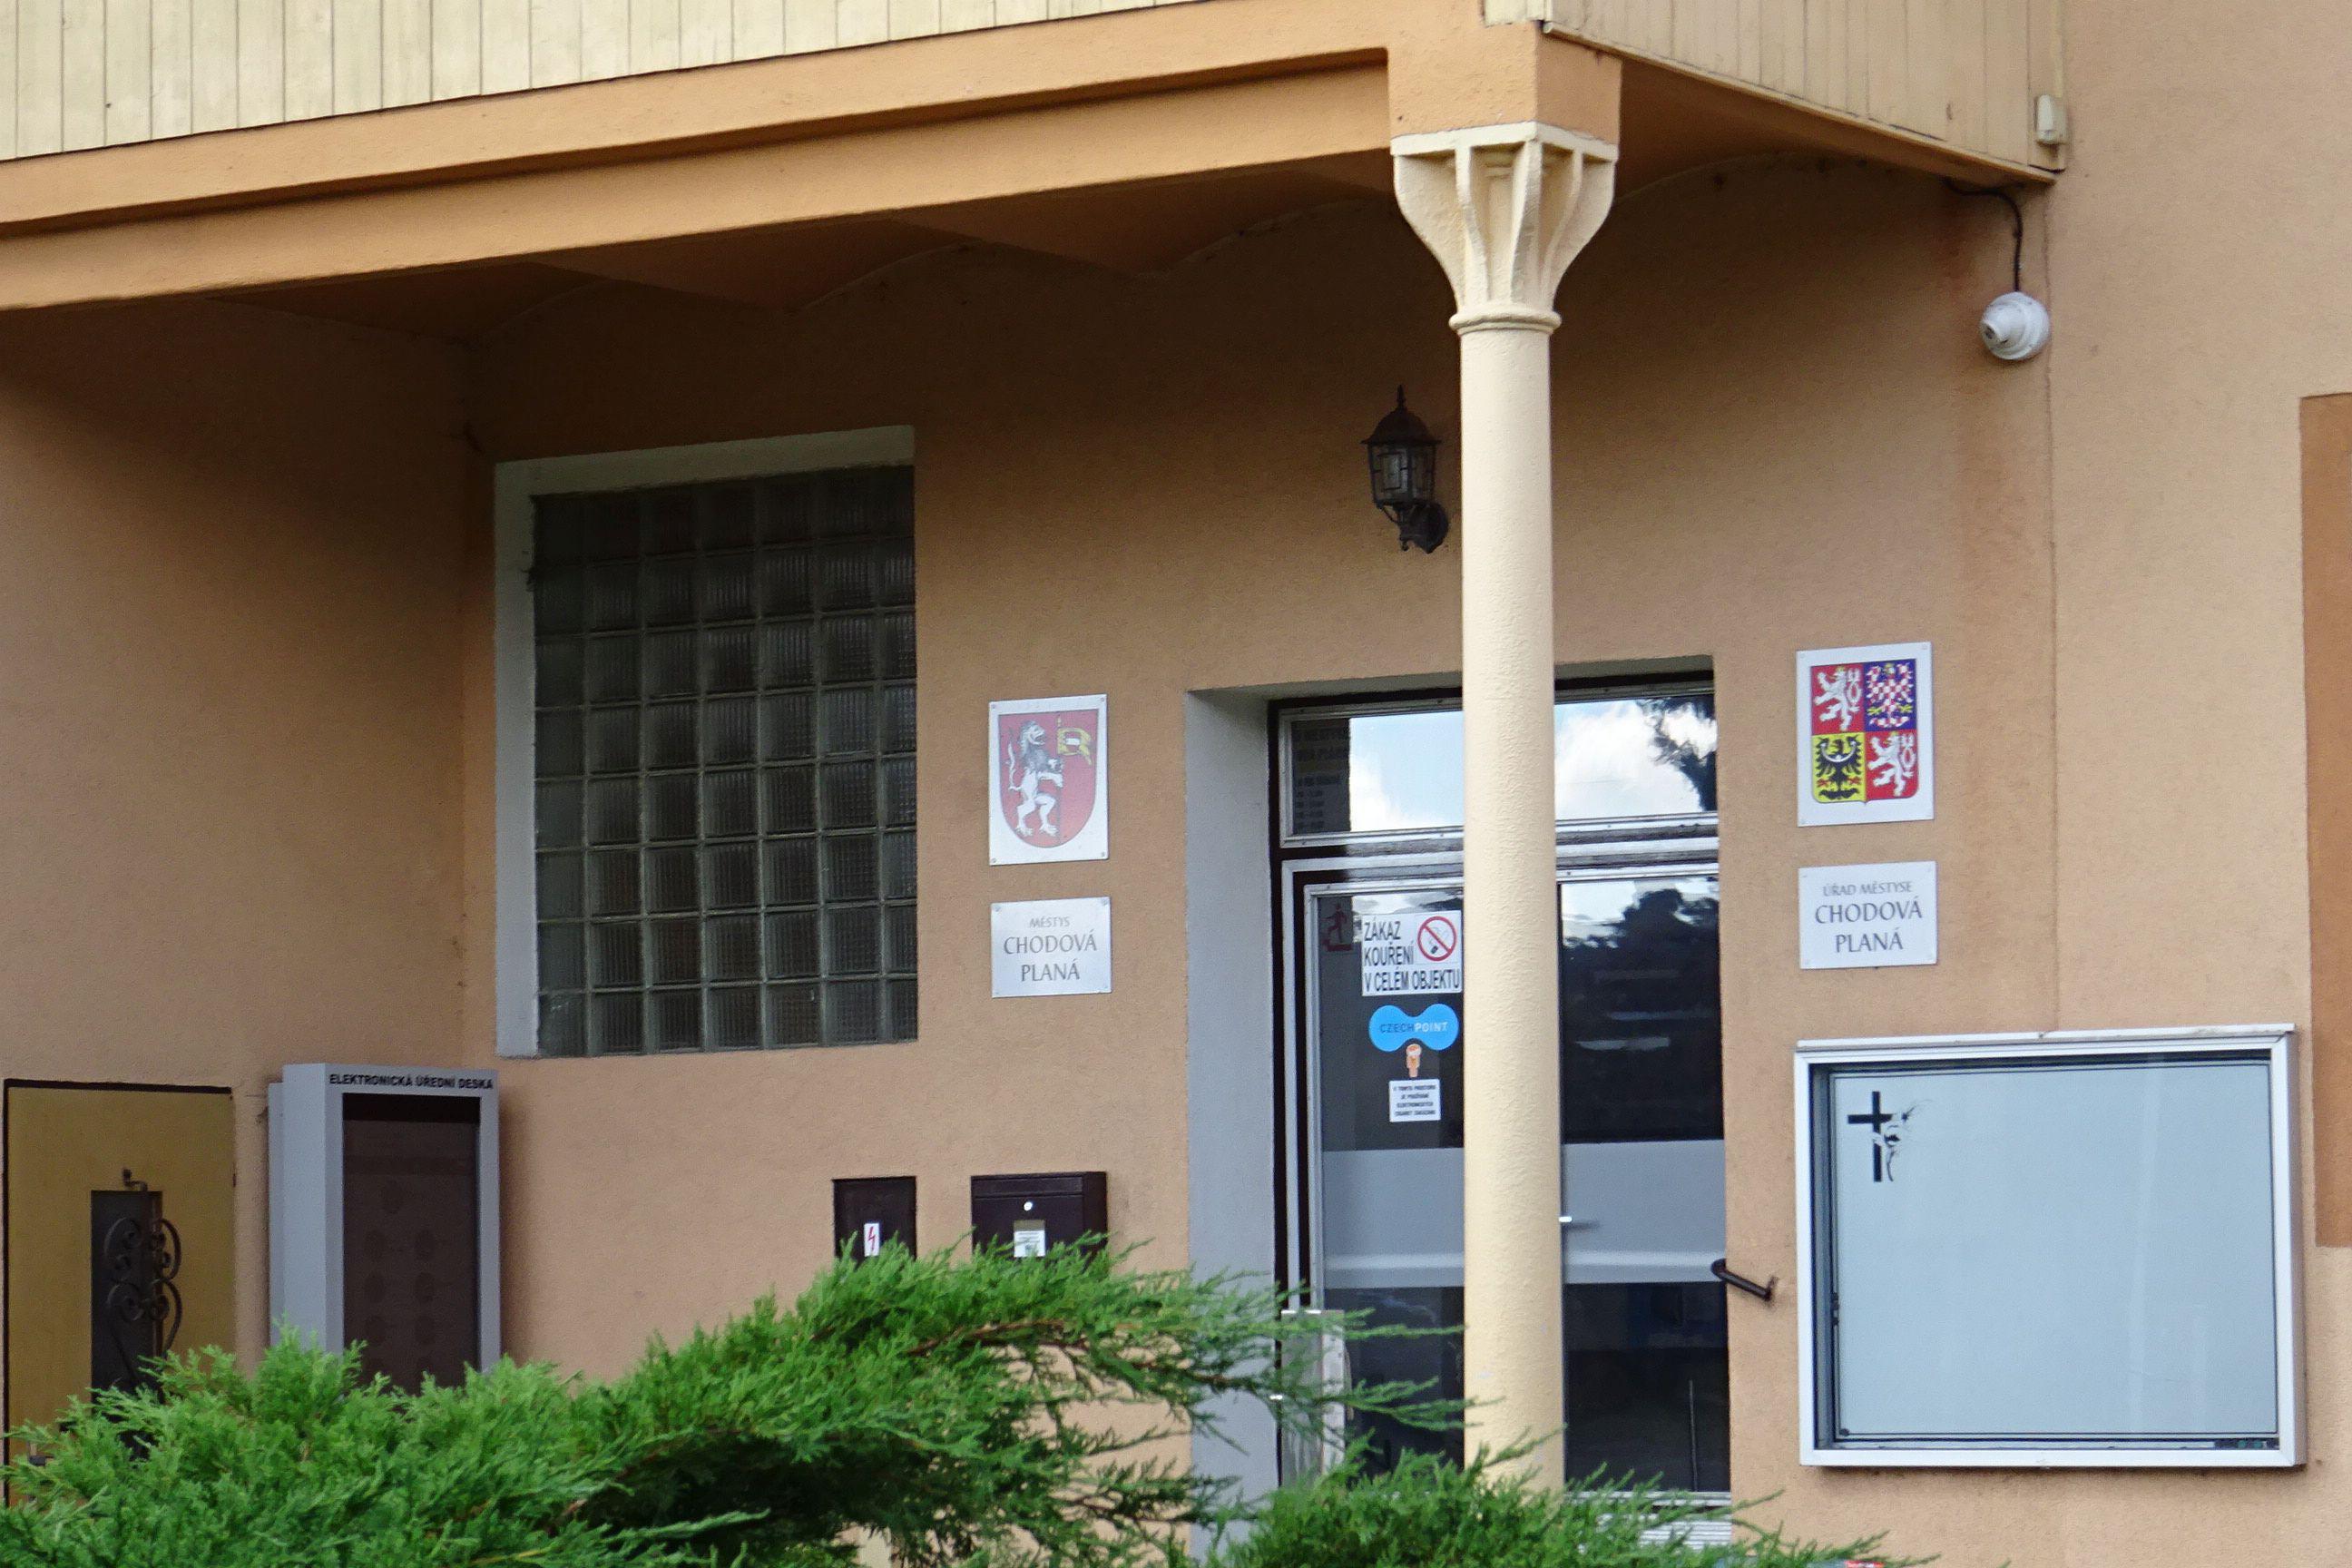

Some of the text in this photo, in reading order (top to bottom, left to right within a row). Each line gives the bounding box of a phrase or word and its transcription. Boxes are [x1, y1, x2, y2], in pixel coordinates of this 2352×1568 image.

[1815, 895, 1923, 924] CHODOVÁ
[1004, 928, 1097, 955] CHODOVÁ
[1364, 917, 1401, 941] ZÁKAZ
[1835, 926, 1904, 953] PLANÁ
[1364, 940, 1414, 966] KOUŘENÍ
[1021, 958, 1080, 982] PLANÁ
[1364, 966, 1460, 992] V CELÉM OBJEKTU
[329, 1073, 413, 1087] ELEKTRONICKÁ
[458, 1077, 493, 1090] DESKA
